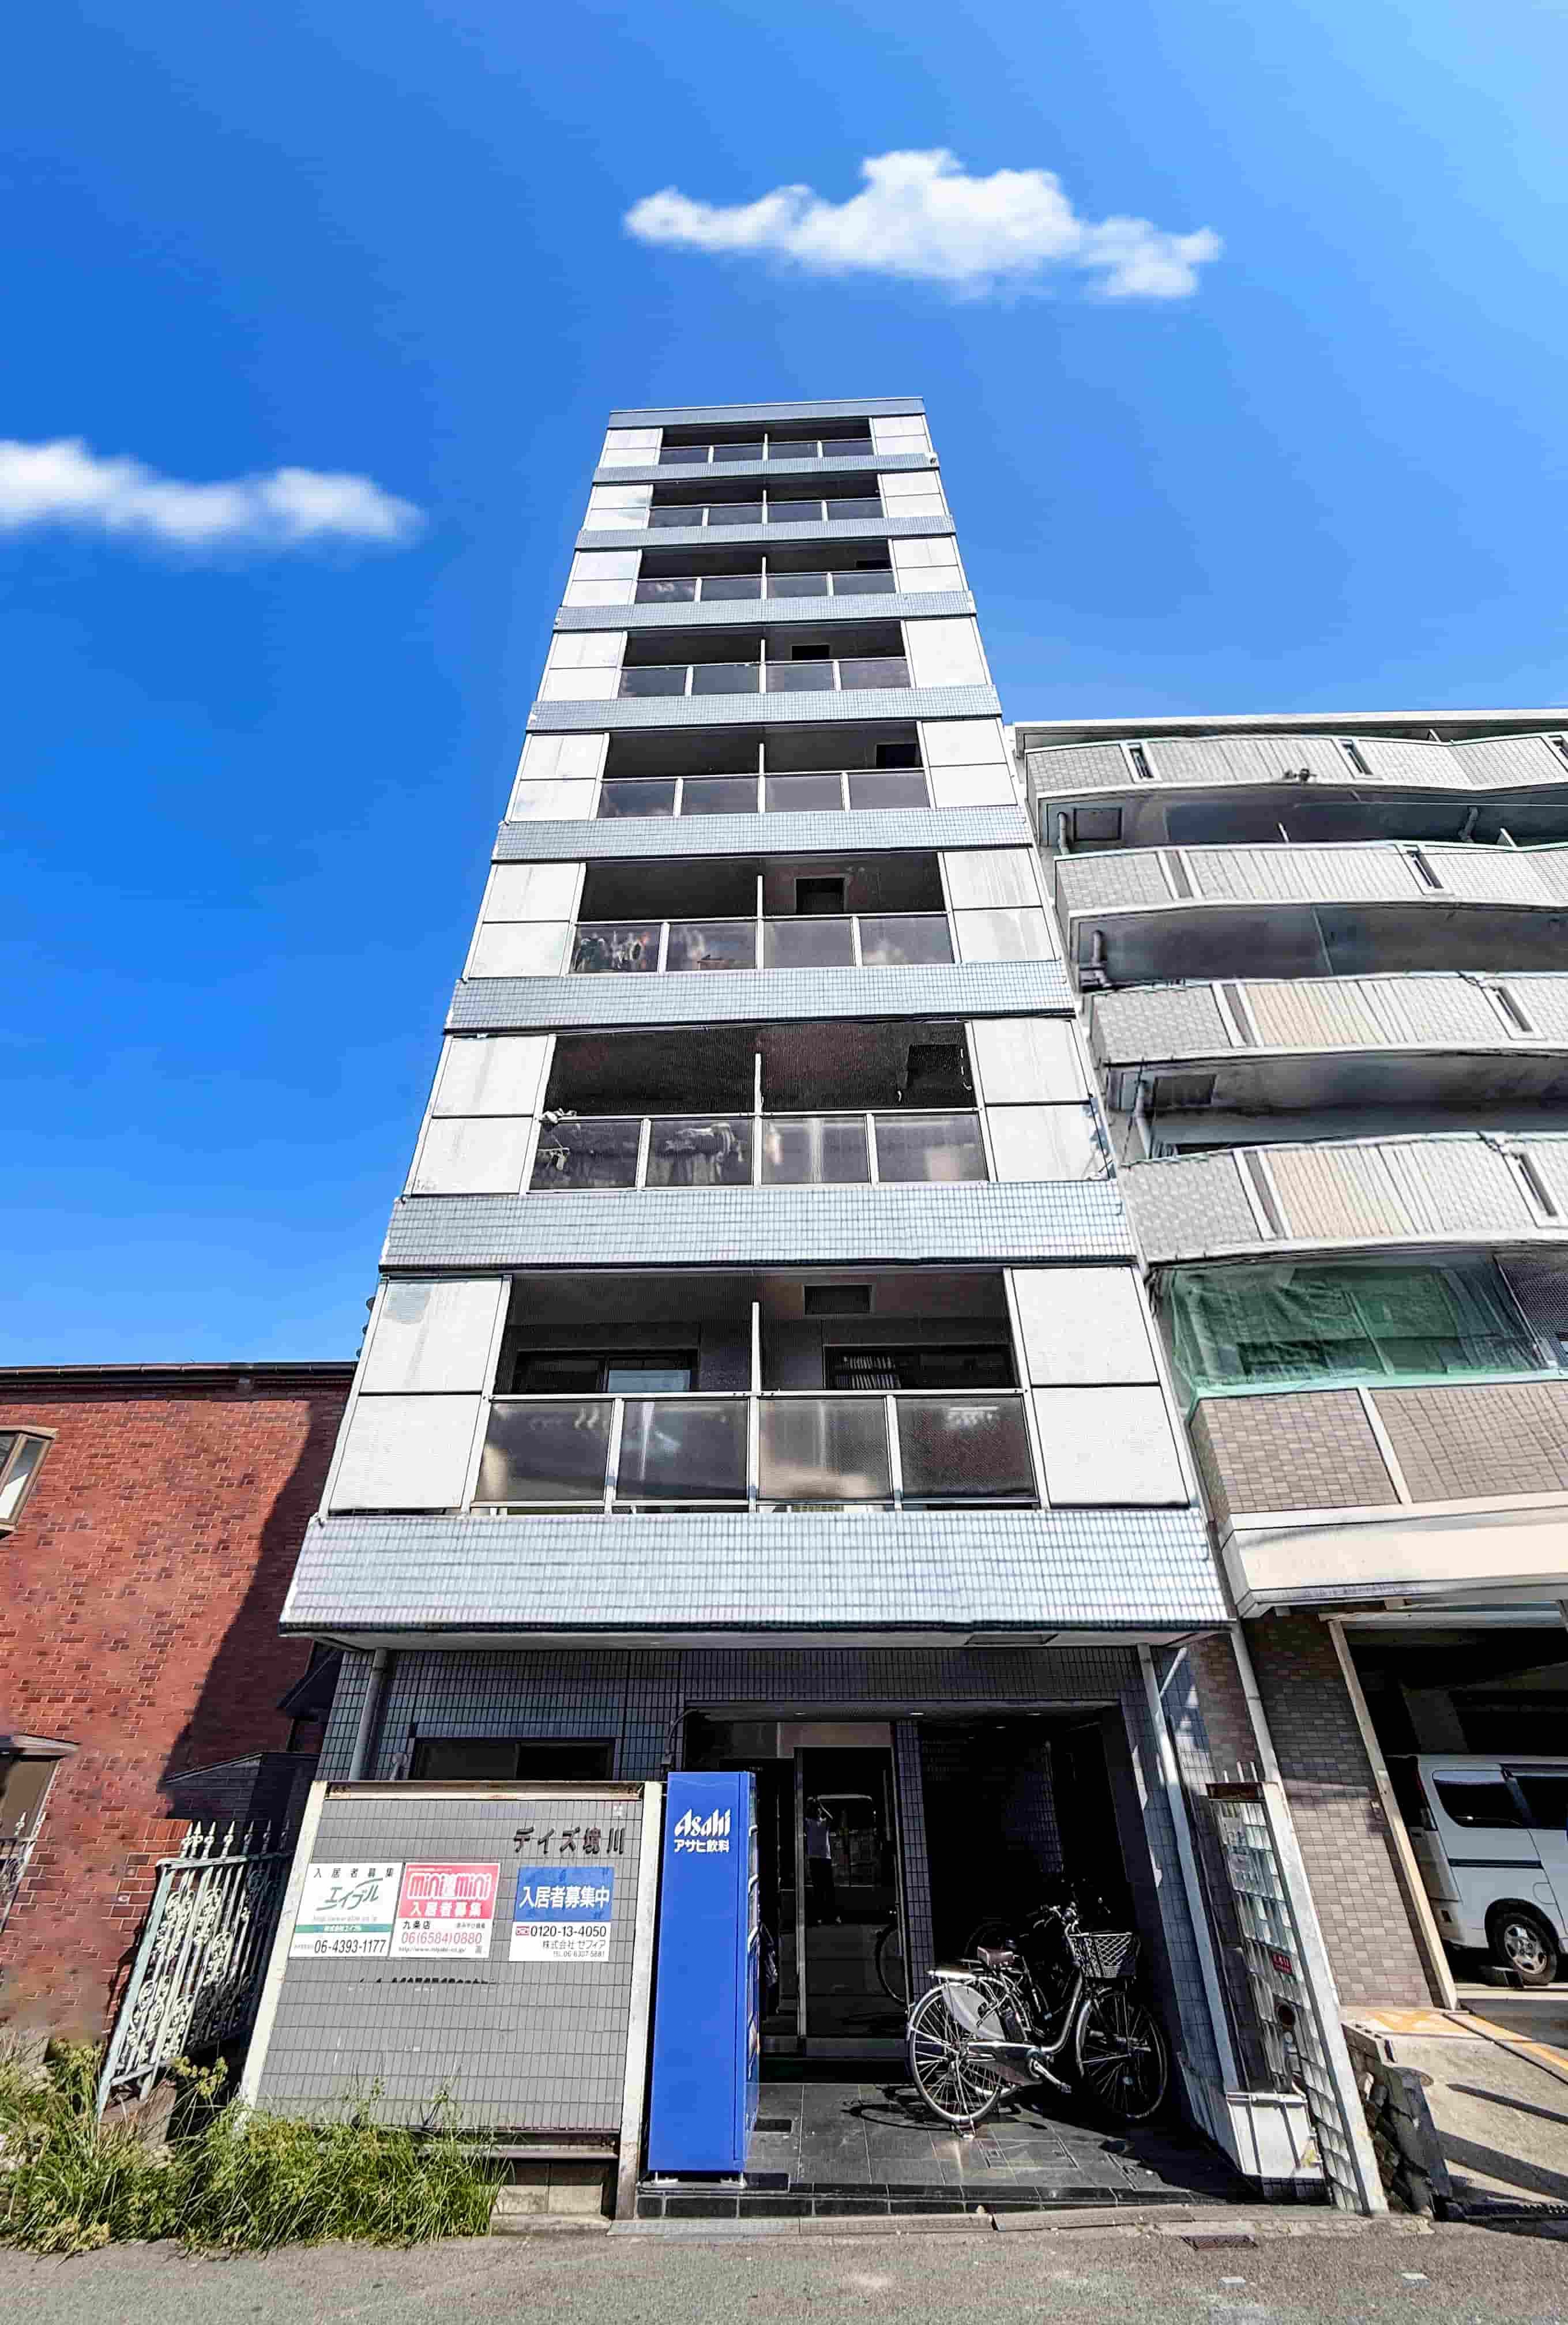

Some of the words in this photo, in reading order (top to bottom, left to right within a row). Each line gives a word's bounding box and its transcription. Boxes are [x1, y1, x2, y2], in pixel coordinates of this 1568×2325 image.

[674, 1808, 731, 1837] Asahi
[674, 1839, 730, 1853] アサヒ飲料
[313, 1868, 393, 1878] 入居者募集
[324, 1884, 379, 1910] エイブル
[519, 1885, 610, 1909] 入居者募集中
[410, 1901, 482, 1917] 入居者募集
[401, 1932, 482, 1945] 06(6584)0880
[530, 1925, 607, 1938] 0120-13-4050
[314, 1939, 386, 1954] 06-4393-1177
